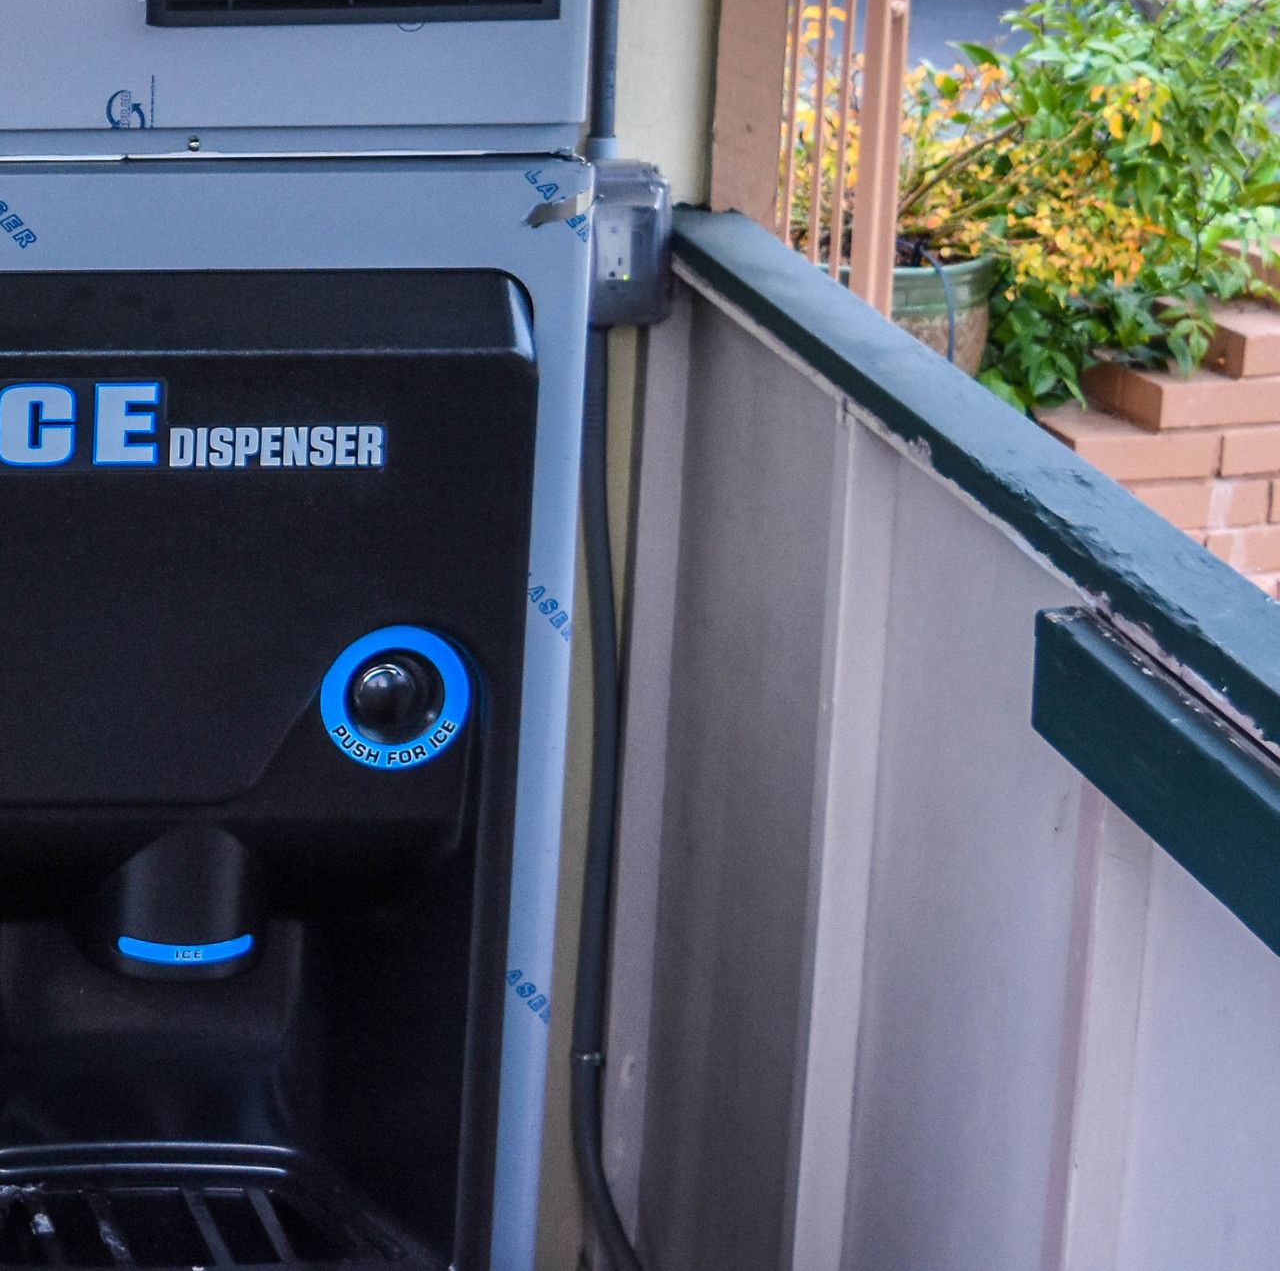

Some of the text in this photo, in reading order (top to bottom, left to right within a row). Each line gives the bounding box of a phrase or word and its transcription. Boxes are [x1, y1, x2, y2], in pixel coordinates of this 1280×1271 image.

[168, 424, 387, 469] DISPENSER
[332, 719, 457, 765] PUSH FOR ICE
[175, 949, 201, 959] ICE
